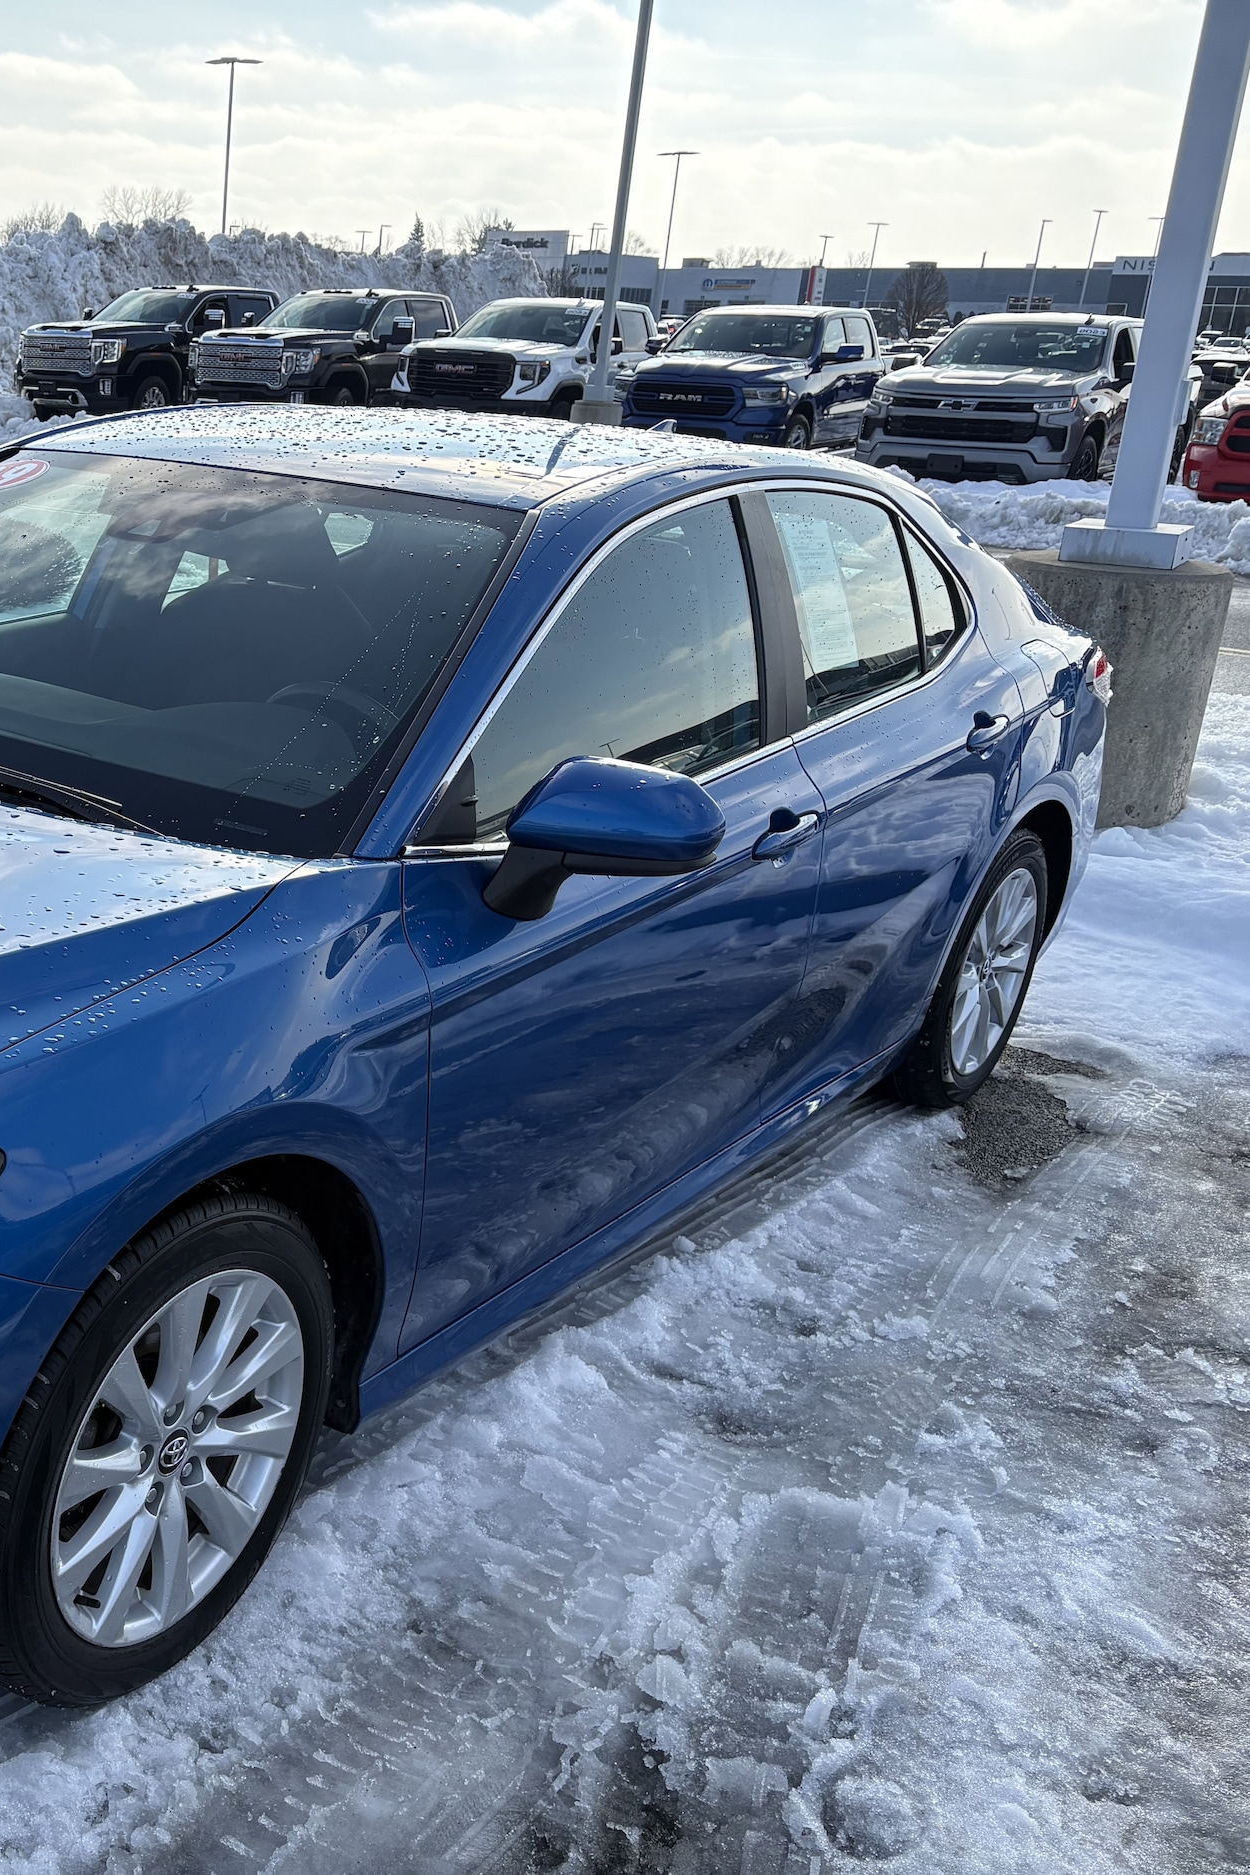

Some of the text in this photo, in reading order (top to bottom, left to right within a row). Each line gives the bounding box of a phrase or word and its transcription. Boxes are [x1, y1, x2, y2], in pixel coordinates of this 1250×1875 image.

[221, 353, 252, 361] GMC
[435, 363, 475, 374] GMC
[659, 392, 703, 402] RAM
